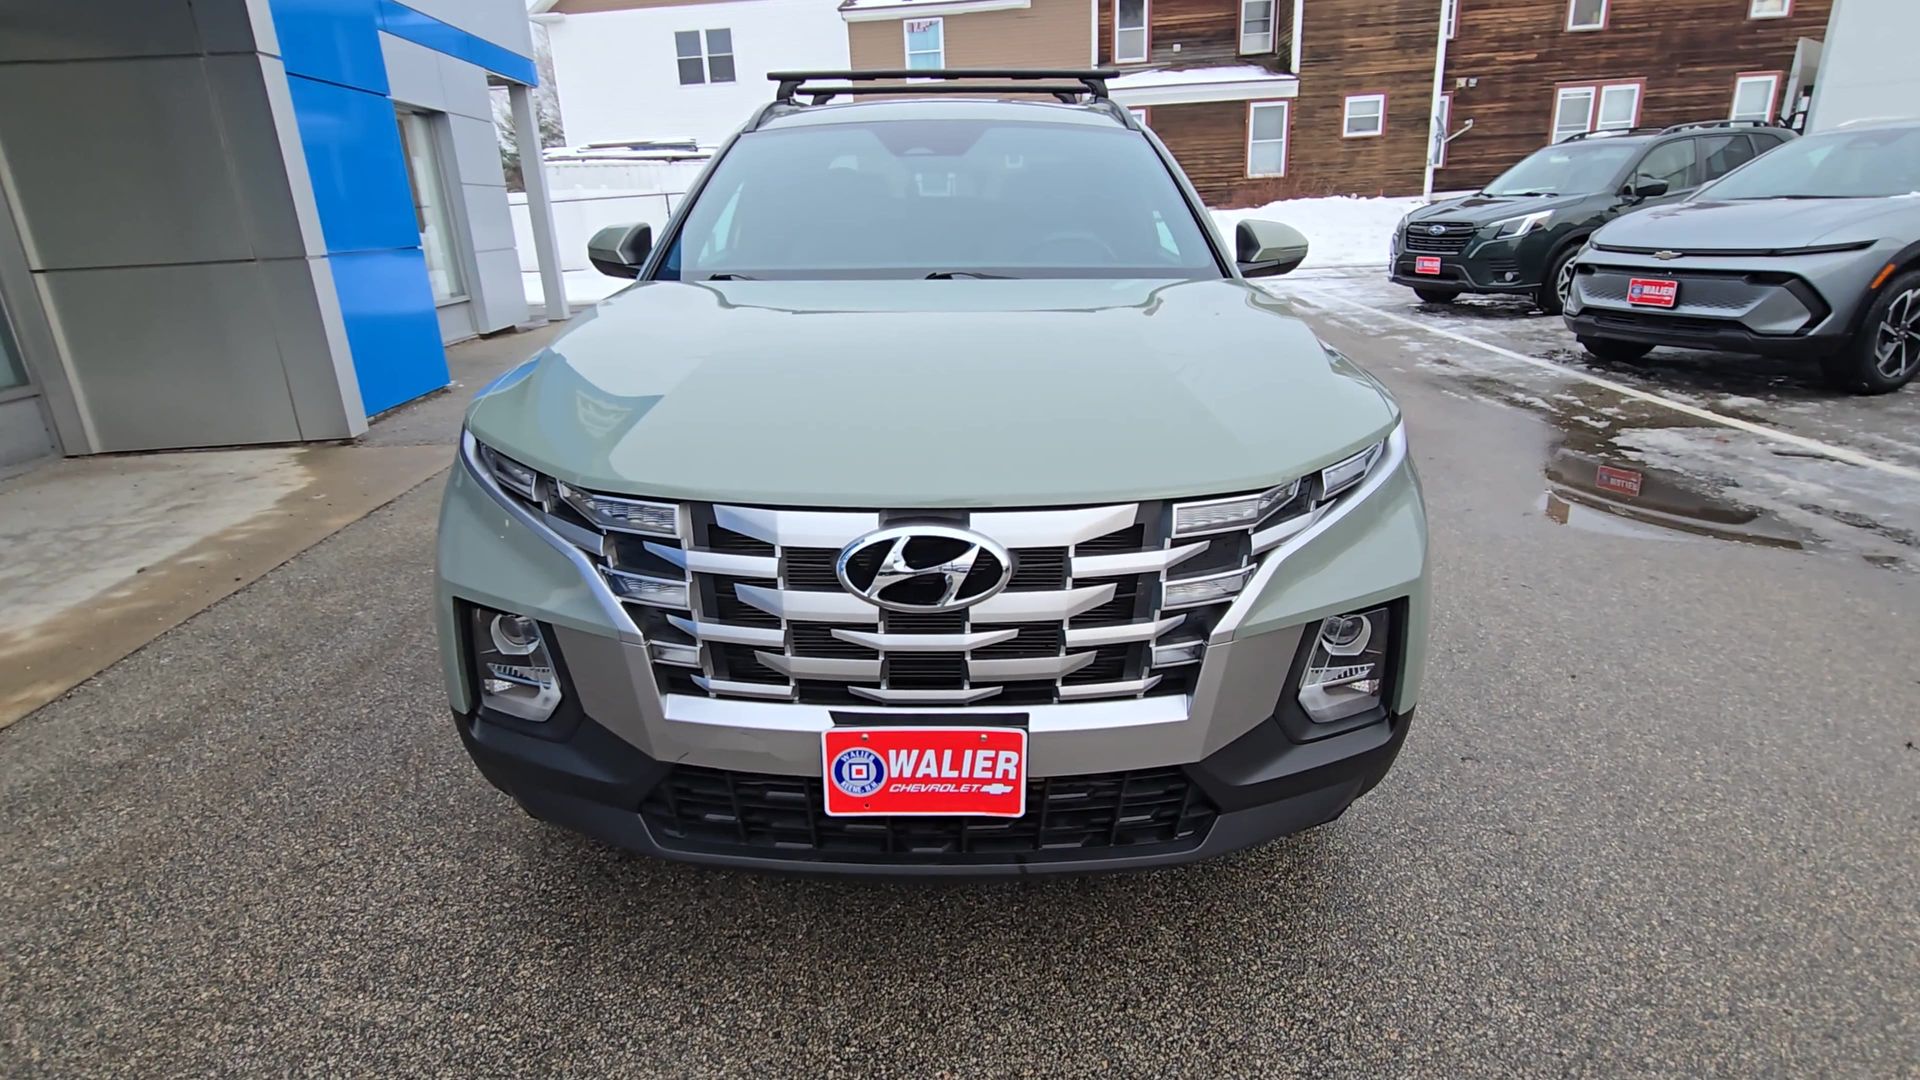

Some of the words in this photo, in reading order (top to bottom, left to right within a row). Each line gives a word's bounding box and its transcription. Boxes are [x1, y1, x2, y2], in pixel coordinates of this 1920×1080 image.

[841, 750, 875, 761] WALIER
[888, 749, 1019, 779] WALIER
[889, 783, 979, 793] CHEVROLET
